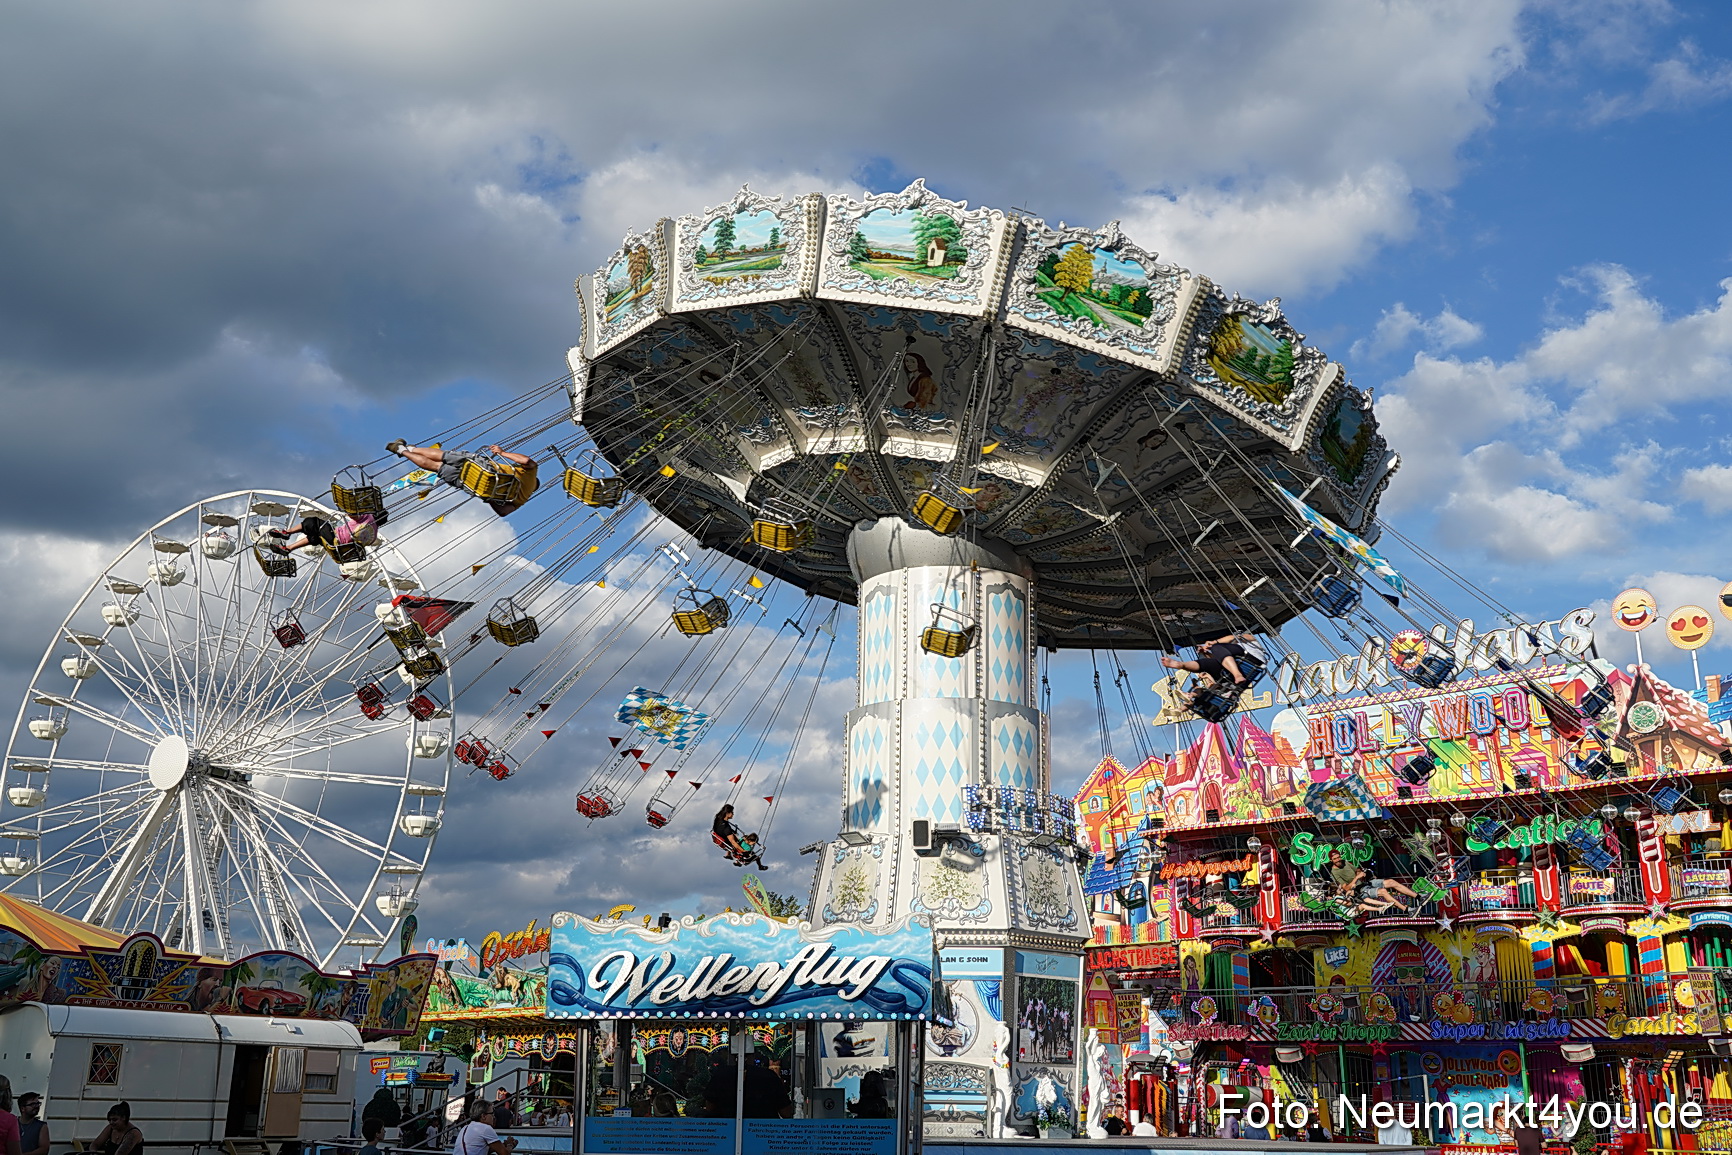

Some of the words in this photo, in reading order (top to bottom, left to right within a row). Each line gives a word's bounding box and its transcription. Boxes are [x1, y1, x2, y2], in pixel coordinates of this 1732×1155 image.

[1275, 635, 1391, 705] Lach
[1422, 607, 1595, 682] Haus
[1152, 668, 1273, 726] XL
[1652, 809, 1722, 836] XXL
[1159, 853, 1253, 880] Hollywood
[1685, 871, 1726, 883] LAUNE!
[1575, 880, 1605, 891] GUTE
[1695, 912, 1730, 922] LABYRINTH
[1088, 947, 1177, 969] LACHSTRASSE
[587, 942, 892, 1006] Wellenflug
[1340, 1021, 1401, 1044] Treppe
[1430, 1019, 1486, 1043] Super
[1489, 1017, 1572, 1041] Rutsche
[1606, 1011, 1678, 1039] Gaudi
[1449, 1072, 1510, 1090] BOULEVARD
